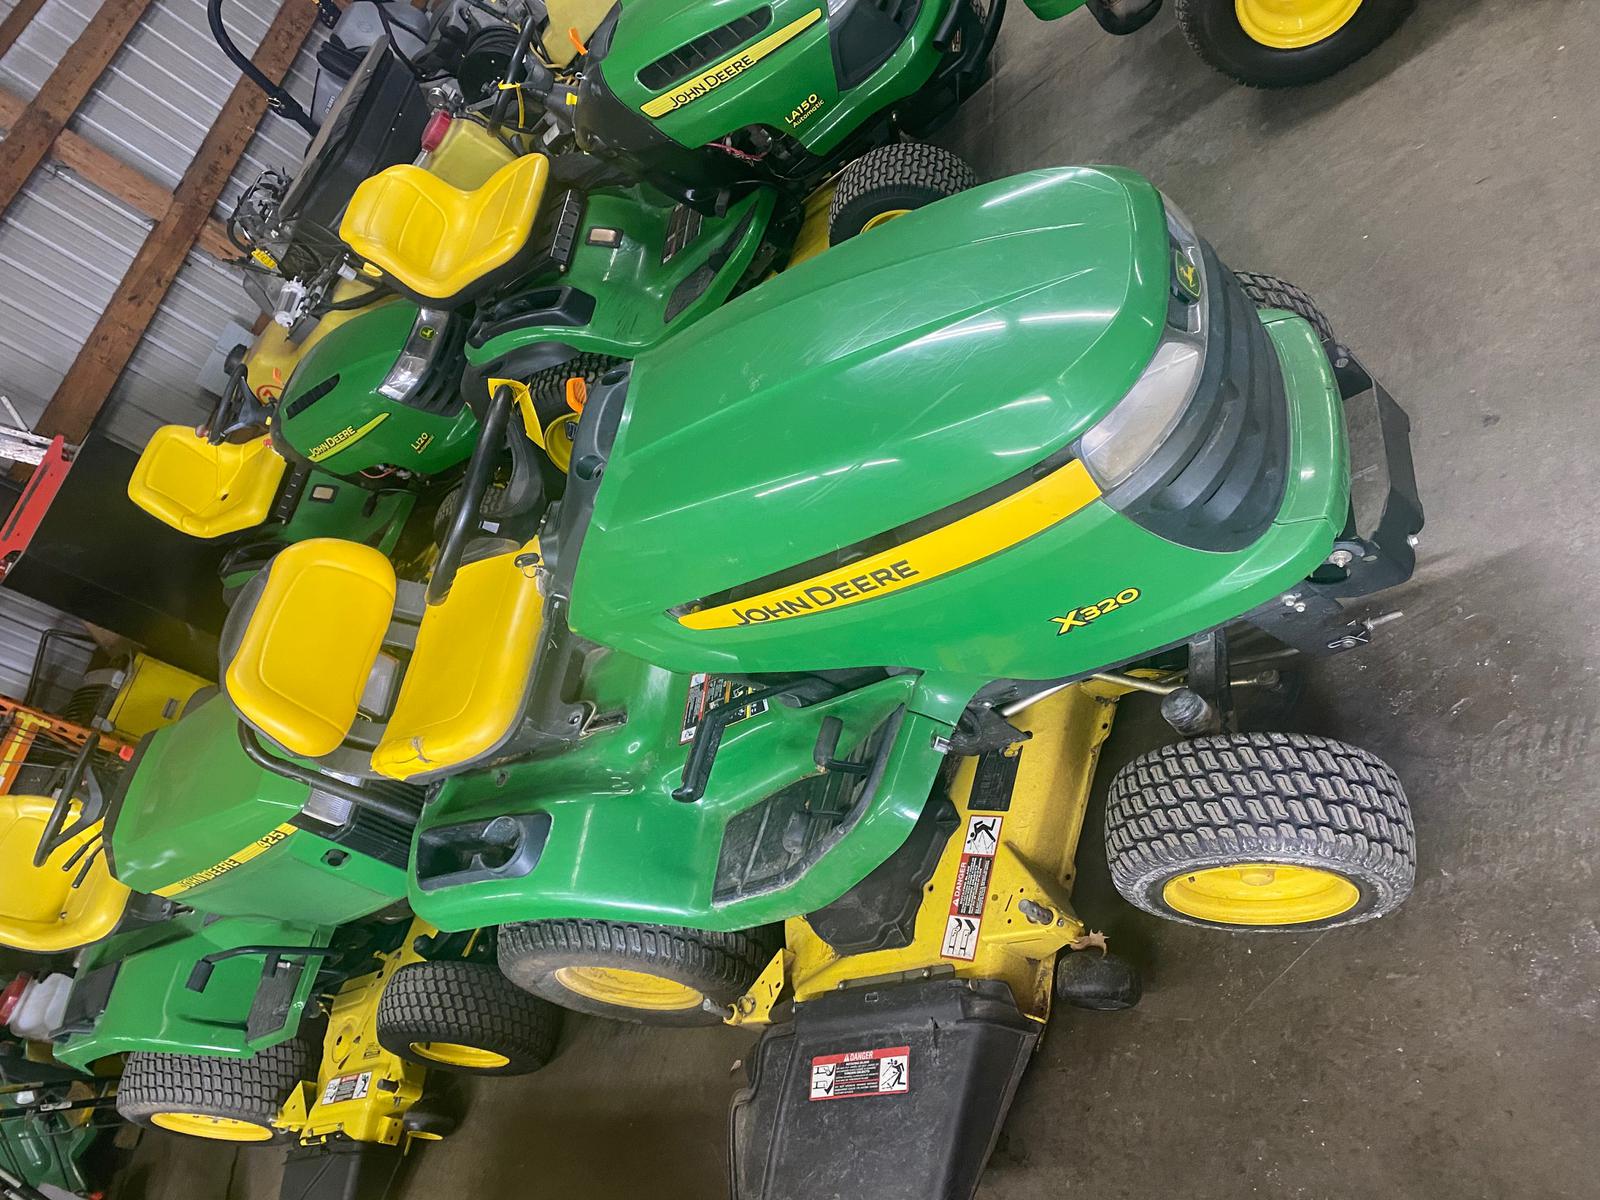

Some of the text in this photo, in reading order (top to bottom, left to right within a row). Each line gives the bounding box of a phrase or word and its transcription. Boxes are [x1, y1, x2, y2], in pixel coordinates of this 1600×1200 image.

[670, 54, 755, 109] JOHN DEERE
[784, 93, 818, 125] LA150
[792, 99, 825, 128] Automatic
[309, 426, 355, 457] JOHN DEERE
[410, 432, 429, 450] L120
[732, 559, 921, 627] JOHN DEERE
[1046, 586, 1143, 637] X320
[257, 830, 285, 849] 425
[202, 859, 239, 881] DEERE
[954, 861, 967, 897] DANGER
[849, 1050, 874, 1061] DANGER
